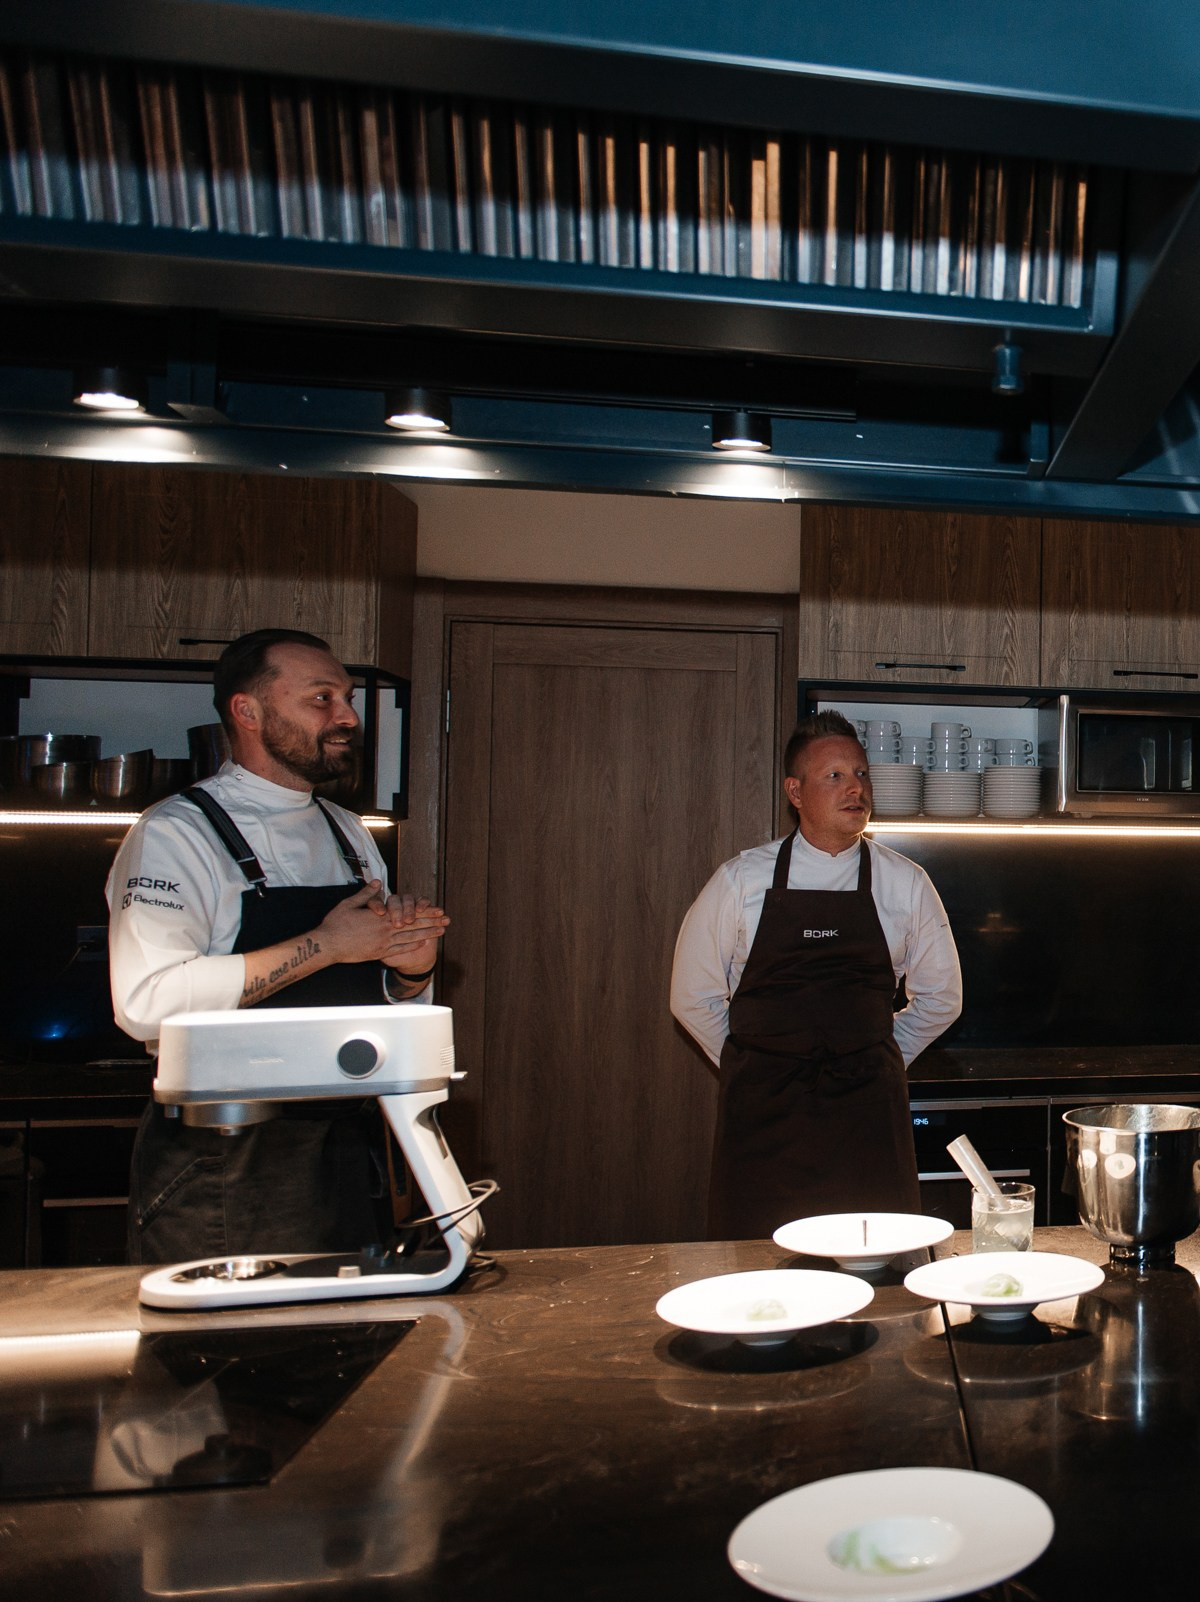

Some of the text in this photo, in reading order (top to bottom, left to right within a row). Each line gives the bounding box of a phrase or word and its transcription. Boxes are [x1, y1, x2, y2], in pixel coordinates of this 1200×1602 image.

[127, 877, 180, 893] BORK
[133, 895, 184, 911] Electrolux
[803, 929, 839, 938] BORK
